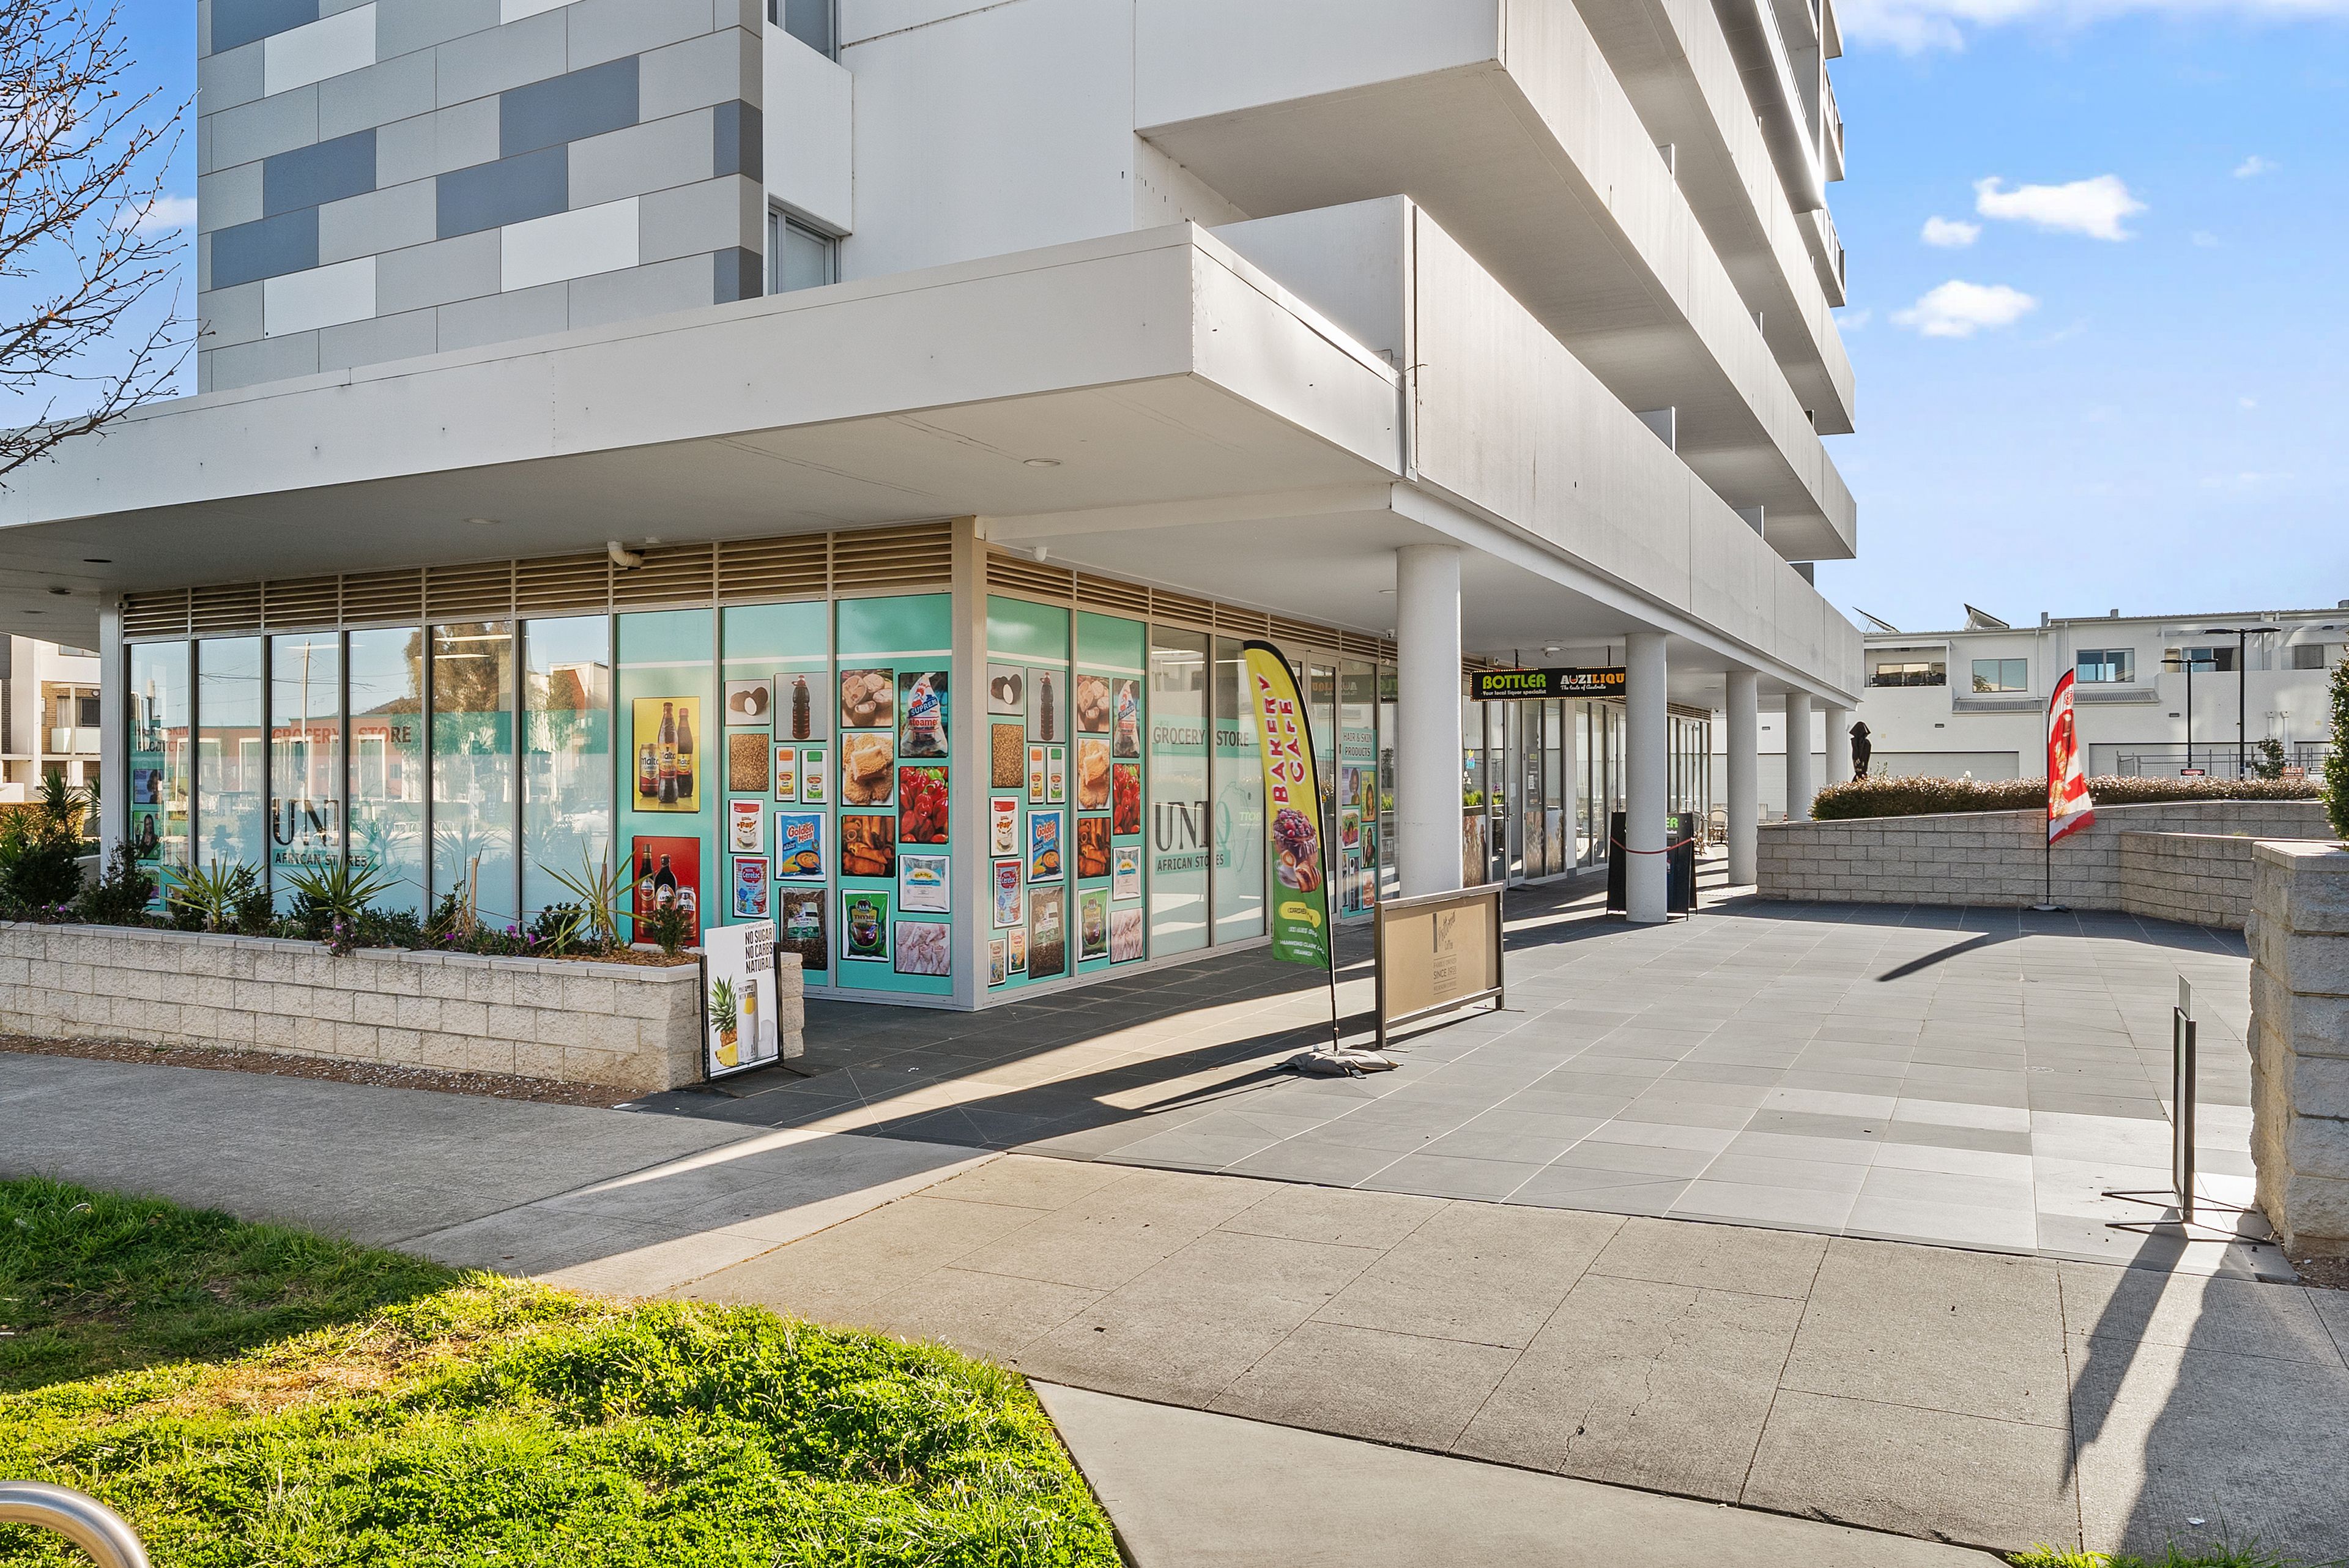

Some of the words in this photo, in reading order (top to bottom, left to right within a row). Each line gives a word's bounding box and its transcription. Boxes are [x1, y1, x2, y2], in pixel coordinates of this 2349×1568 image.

[1482, 674, 1546, 689] BOTTLER
[272, 728, 339, 744] GROCERY
[358, 726, 412, 743] STORE
[1153, 726, 1206, 745] GROCERY
[1216, 730, 1249, 747] STORE
[1257, 674, 1289, 803] BAKERY
[1279, 701, 1305, 782] CAFE
[1343, 732, 1356, 741] HAIR
[1345, 746, 1370, 757] PRODUCTS
[788, 824, 814, 838] Golden
[275, 852, 321, 866] AFRICAN
[325, 853, 367, 868] STRES
[1157, 856, 1192, 872] AFRICAN
[1195, 853, 1224, 869] STOES
[745, 931, 754, 945] NO
[754, 927, 773, 943] SUGAR
[745, 945, 754, 959] NO
[755, 942, 773, 957] CARBS
[746, 956, 774, 974] NATURAL.
[1433, 968, 1447, 979] SINCE
